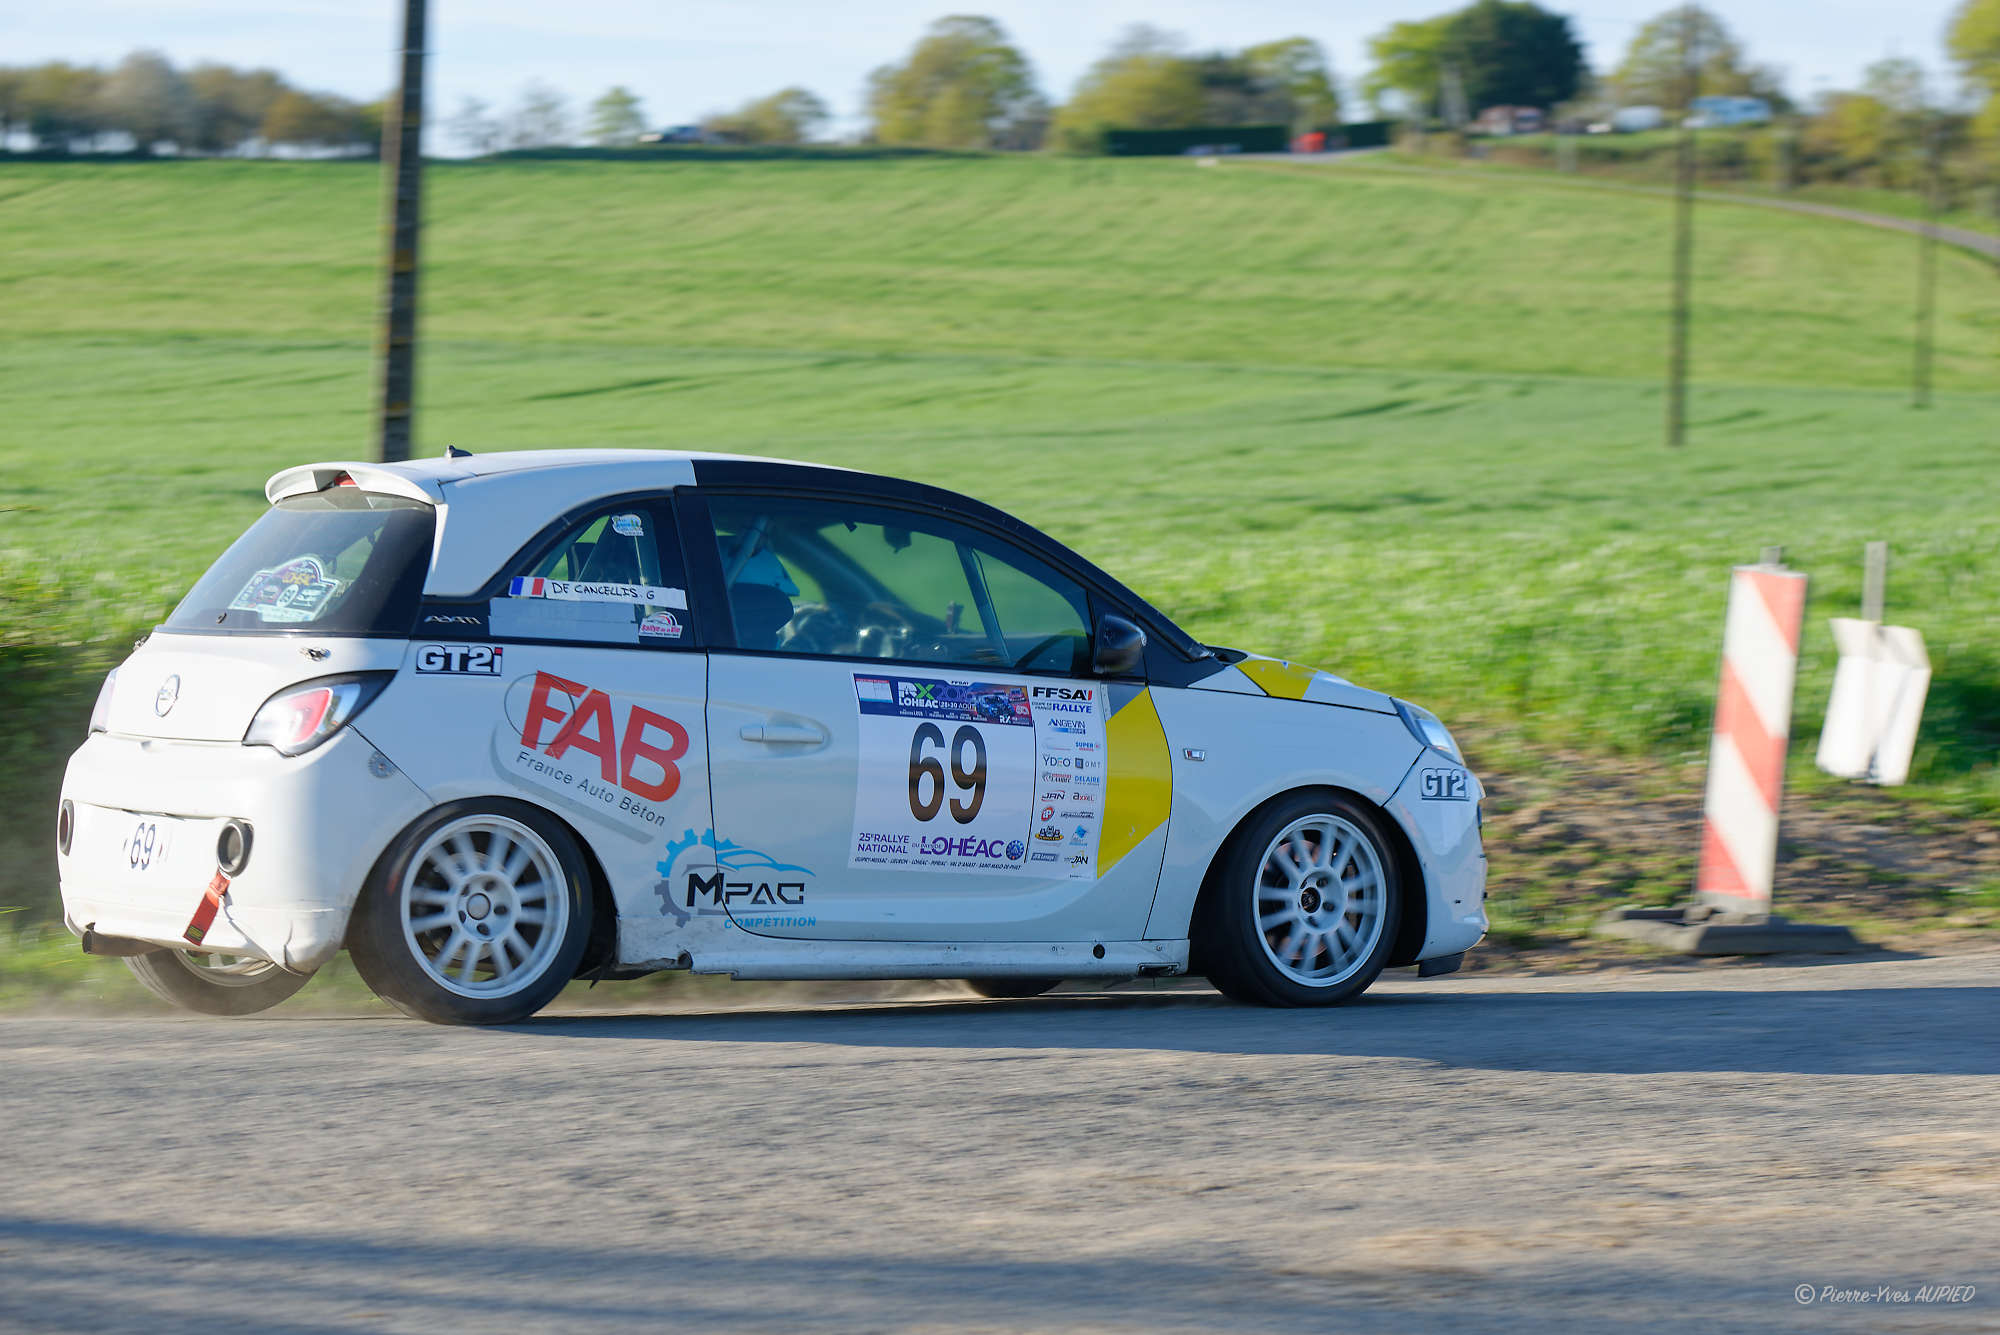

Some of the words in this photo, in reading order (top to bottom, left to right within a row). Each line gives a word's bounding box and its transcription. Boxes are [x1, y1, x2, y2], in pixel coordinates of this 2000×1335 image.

[552, 582, 570, 594] DE
[646, 590, 655, 600] G
[417, 646, 503, 674] GT2i
[1032, 687, 1087, 701] FFSA
[1053, 703, 1093, 714] RALLYE
[520, 670, 690, 802] FAB
[909, 722, 987, 824] 69
[1421, 768, 1468, 798] GT2
[516, 751, 573, 785] France
[577, 778, 614, 804] Auto
[619, 796, 666, 827] Béton
[130, 822, 156, 871] 69
[858, 843, 909, 854] NATIONAL
[874, 834, 910, 844] RALLYE
[920, 835, 1005, 859] LOHÉAC
